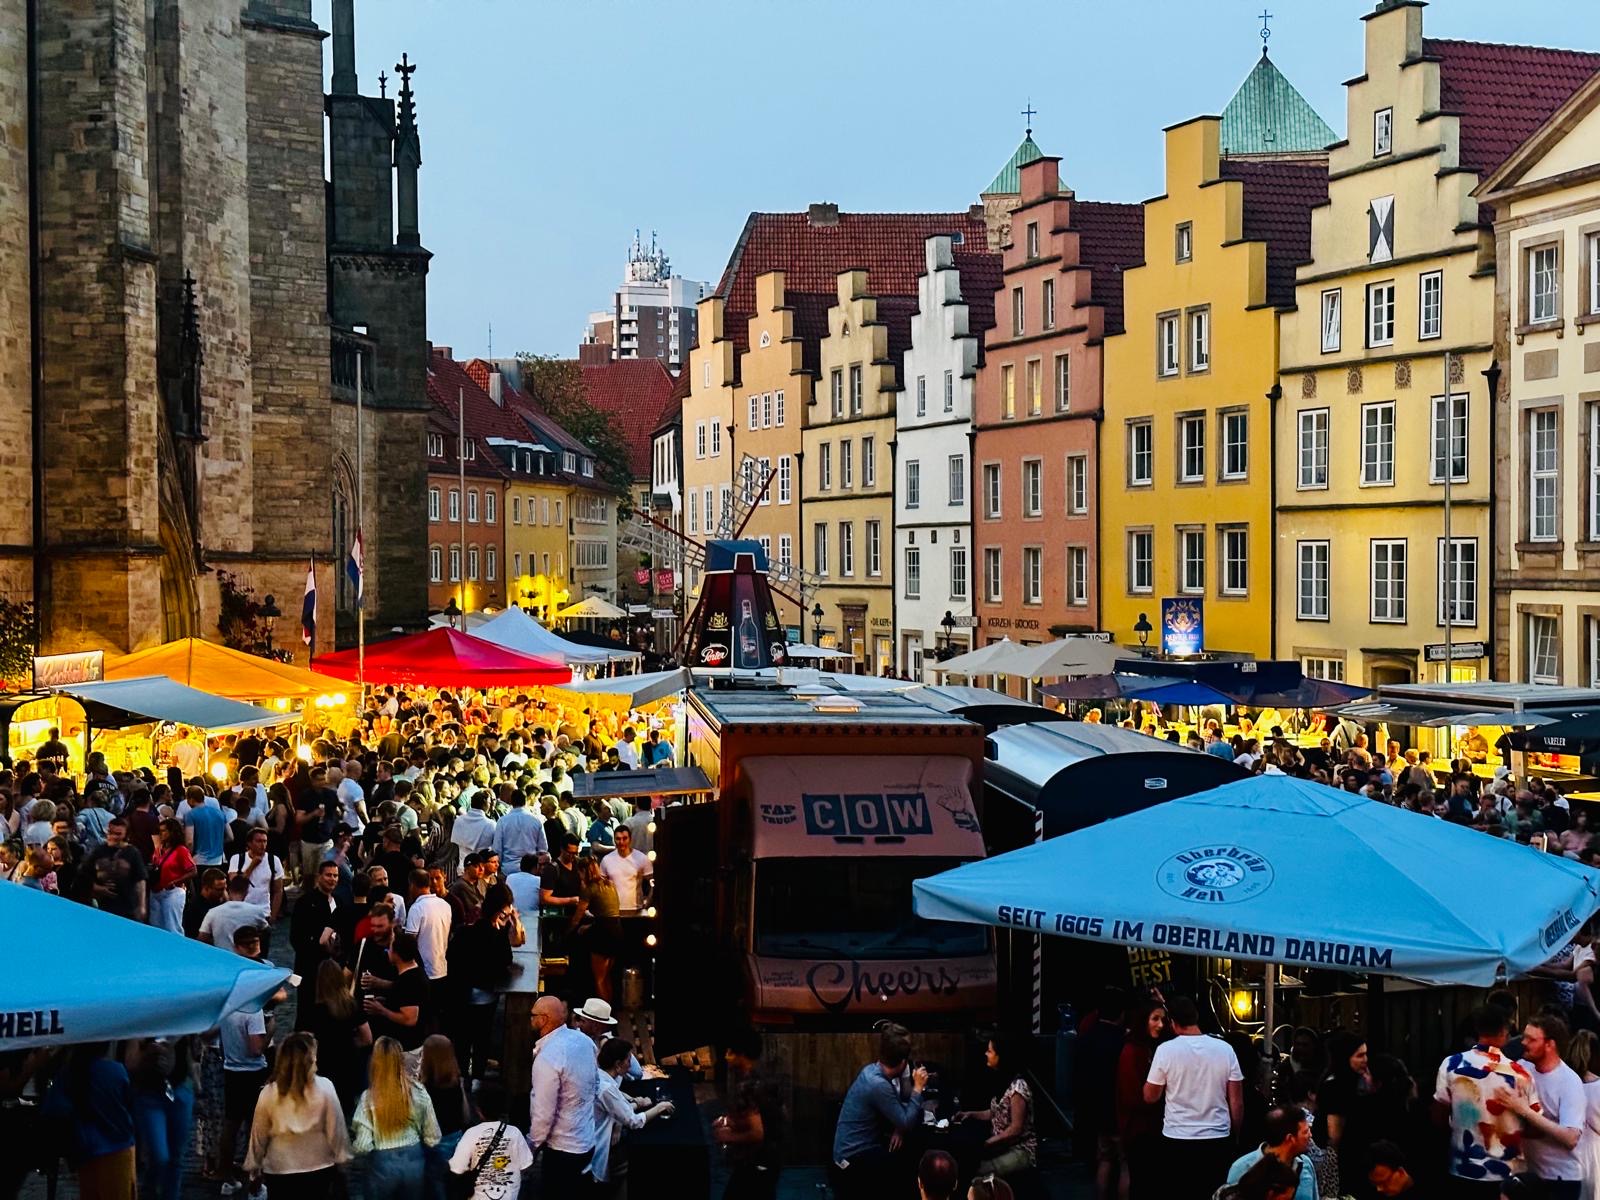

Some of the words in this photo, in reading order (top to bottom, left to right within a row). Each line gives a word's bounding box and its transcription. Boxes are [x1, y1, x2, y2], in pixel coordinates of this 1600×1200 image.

[760, 804, 796, 815] TAP
[761, 815, 797, 825] TRUCK
[812, 798, 923, 829] COW
[1181, 886, 1225, 902] Hell
[998, 905, 1046, 929] SEIT
[1055, 913, 1104, 937] 1605
[1112, 920, 1145, 942] IM
[1152, 923, 1276, 957] OBERLAND
[1284, 937, 1393, 969] DAHOAM
[806, 959, 960, 1013] Cheers
[1131, 960, 1171, 987] FEST
